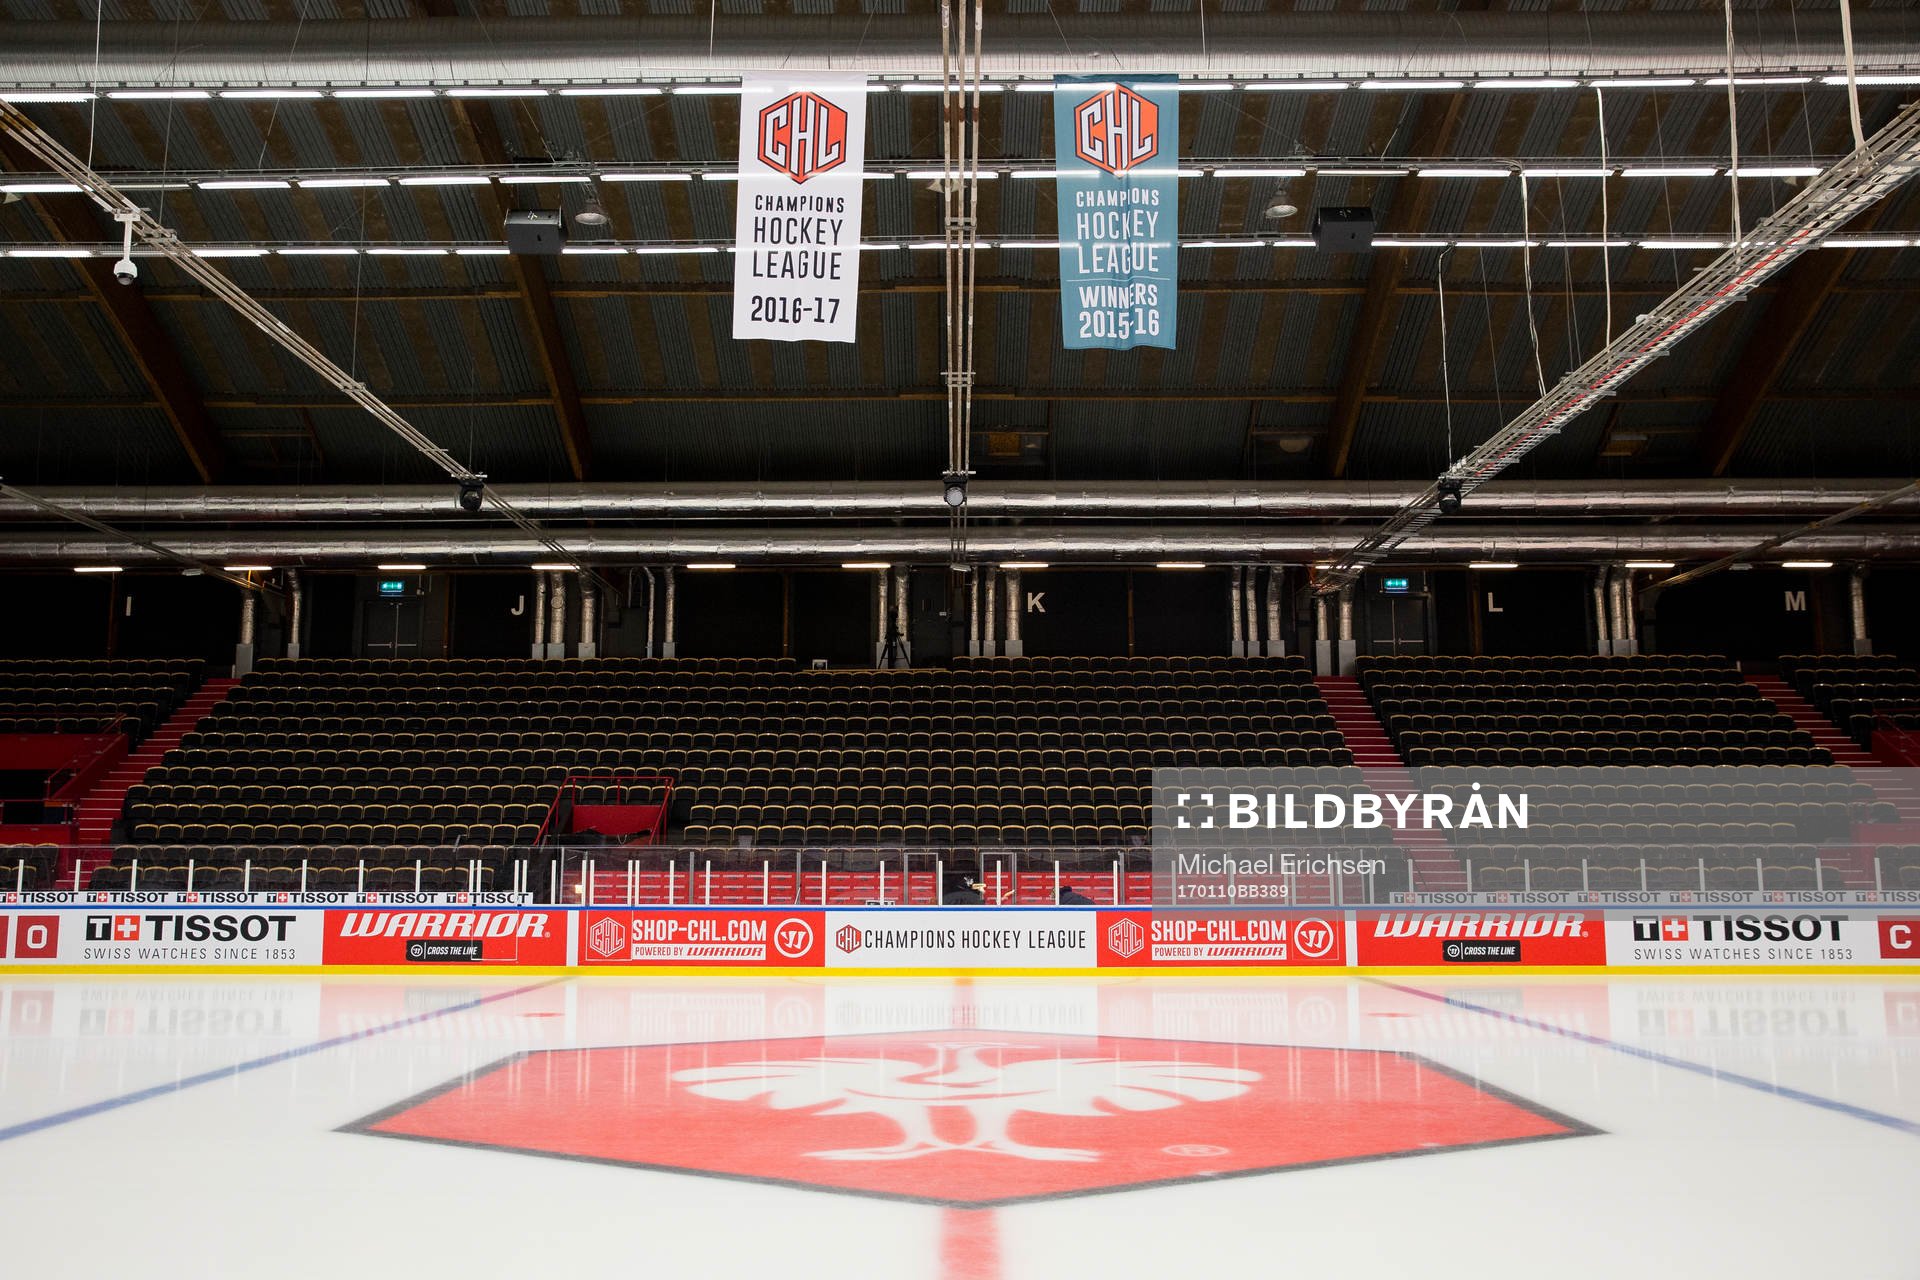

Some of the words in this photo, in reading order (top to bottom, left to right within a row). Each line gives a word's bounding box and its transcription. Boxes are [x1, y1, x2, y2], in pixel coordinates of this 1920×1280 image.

[763, 97, 842, 178] CHL
[1080, 91, 1154, 170] CHL
[754, 194, 845, 214] CHAMPIONS
[1076, 188, 1160, 208] CHAMPIONS
[754, 216, 844, 246] HOCKEY
[1077, 209, 1159, 240] HOCKEY
[752, 249, 842, 281] LEAGUE
[1078, 242, 1159, 275] LEAGUE
[1079, 282, 1158, 310] WINNERS
[750, 295, 840, 325] 2016-17
[1079, 307, 1160, 340] 2015-16
[511, 595, 525, 616] J
[1027, 592, 1046, 613] K
[1488, 592, 1504, 612] L
[1785, 591, 1806, 611] M
[20, 892, 78, 903] TISSOT
[110, 892, 168, 904] TISSOT
[199, 892, 258, 904] TISSOT
[290, 892, 349, 904] TISSOT
[379, 892, 438, 904] TISSOT
[1418, 892, 1477, 903] TISSOT
[1510, 892, 1569, 903] TISSOT
[1601, 892, 1660, 903] TISSOT
[1693, 892, 1753, 903] TISSOT
[1786, 892, 1846, 903] TISSOT
[1880, 891, 1920, 903] TISS
[145, 915, 296, 942] TISSOT
[632, 919, 767, 942] SHOP-CHL.COM
[1151, 919, 1287, 942] SHOP-CHL.COM
[1693, 914, 1848, 942] TISSOT
[864, 929, 955, 949] CHAMPIONS
[962, 929, 1021, 949] HOCKEY
[1028, 929, 1086, 949] LEAGUE
[84, 948, 131, 960] SWISS
[138, 948, 207, 960] WATCHES
[214, 948, 257, 960] SINCE
[265, 948, 296, 960] 1853
[427, 946, 448, 955] CROSS
[450, 946, 461, 955] THE
[463, 946, 478, 955] LINE
[635, 946, 672, 957] POWERED
[673, 946, 684, 957] BY
[687, 947, 763, 957] WARRIOR
[1154, 947, 1191, 957] POWERED
[1193, 947, 1203, 957] BY
[1207, 947, 1284, 957] WARRIOR
[1464, 946, 1486, 956] CROSS
[1487, 946, 1499, 956] THE
[1500, 946, 1516, 956] LINE
[1634, 948, 1682, 960] SWISS
[1689, 948, 1760, 960] WATCHES
[1768, 948, 1813, 960] SINCE
[1821, 948, 1853, 960] 1853
